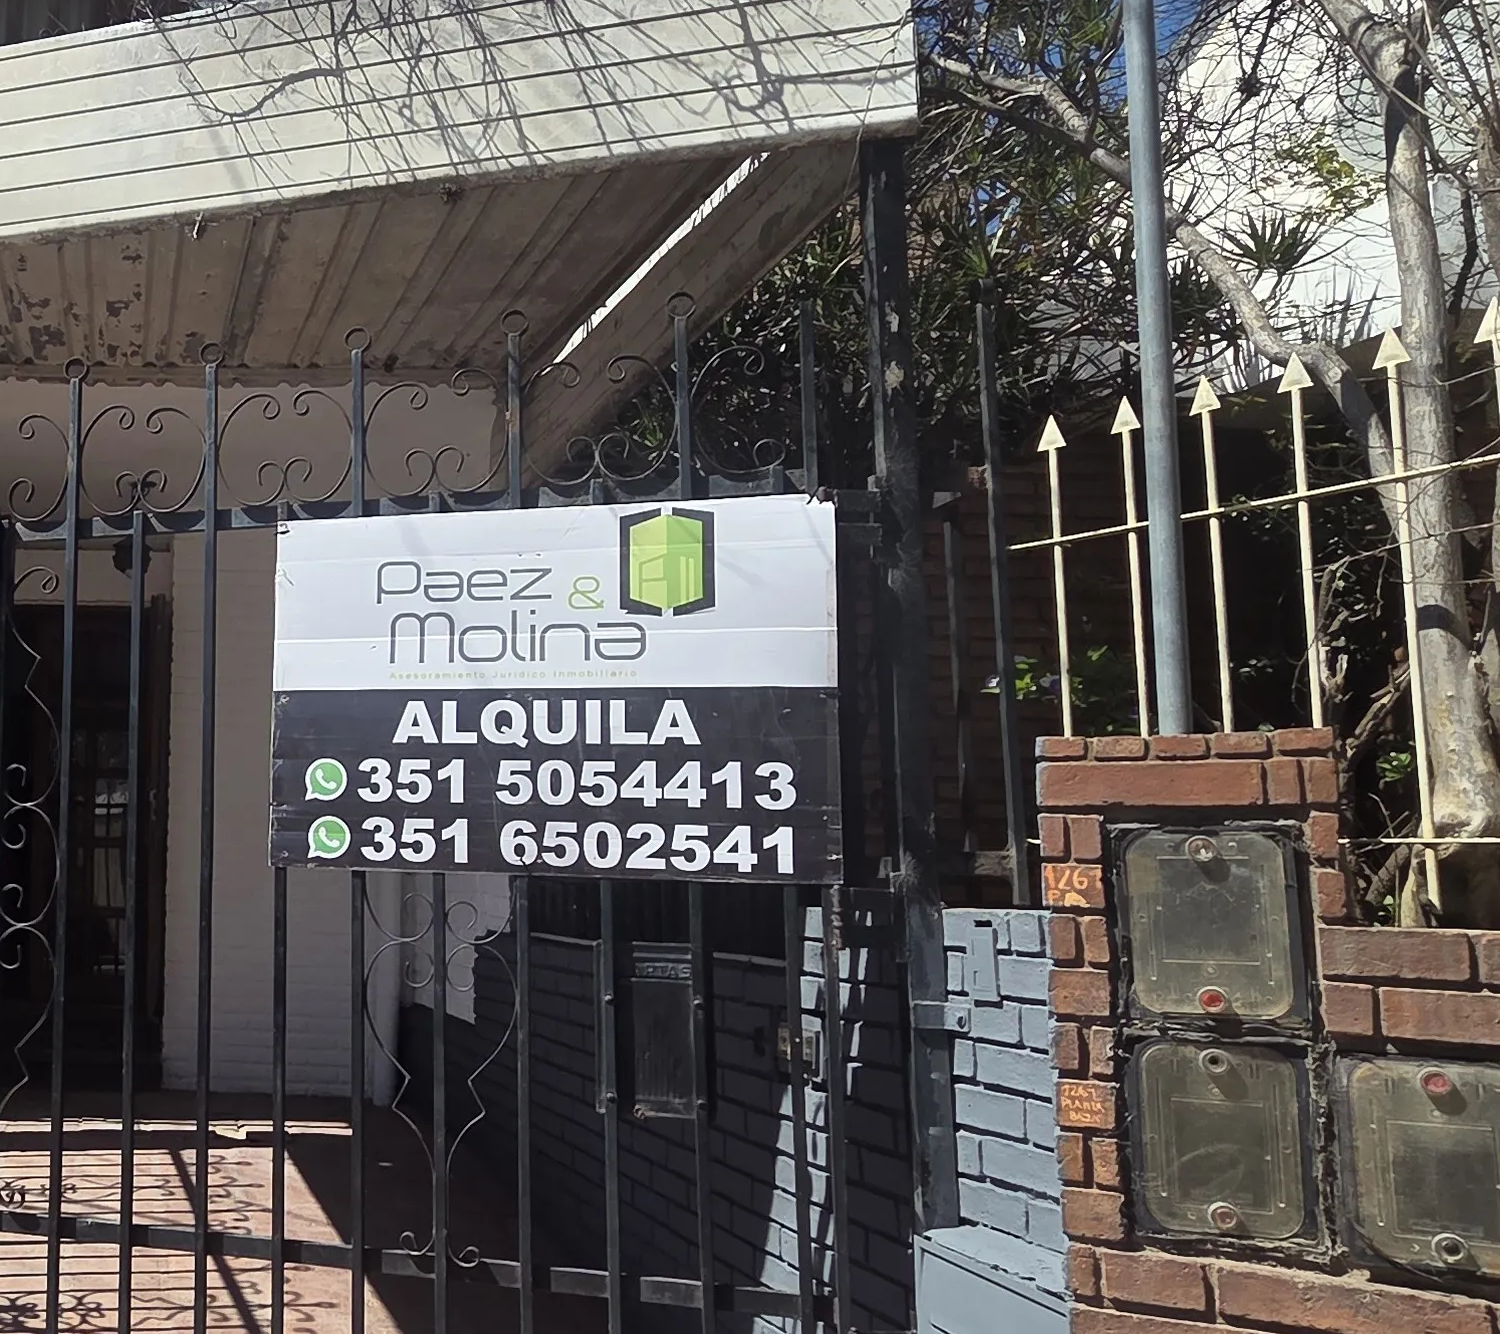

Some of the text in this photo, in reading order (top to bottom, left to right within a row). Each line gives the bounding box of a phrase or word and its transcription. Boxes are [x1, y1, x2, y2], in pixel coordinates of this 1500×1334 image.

[376, 560, 604, 610] Paez &
[389, 609, 647, 664] Molina
[389, 671, 486, 680] Asesoramiento
[392, 699, 701, 748] ALQUILA
[357, 757, 797, 810] 351 5054413
[360, 816, 795, 874] 351 6502541
